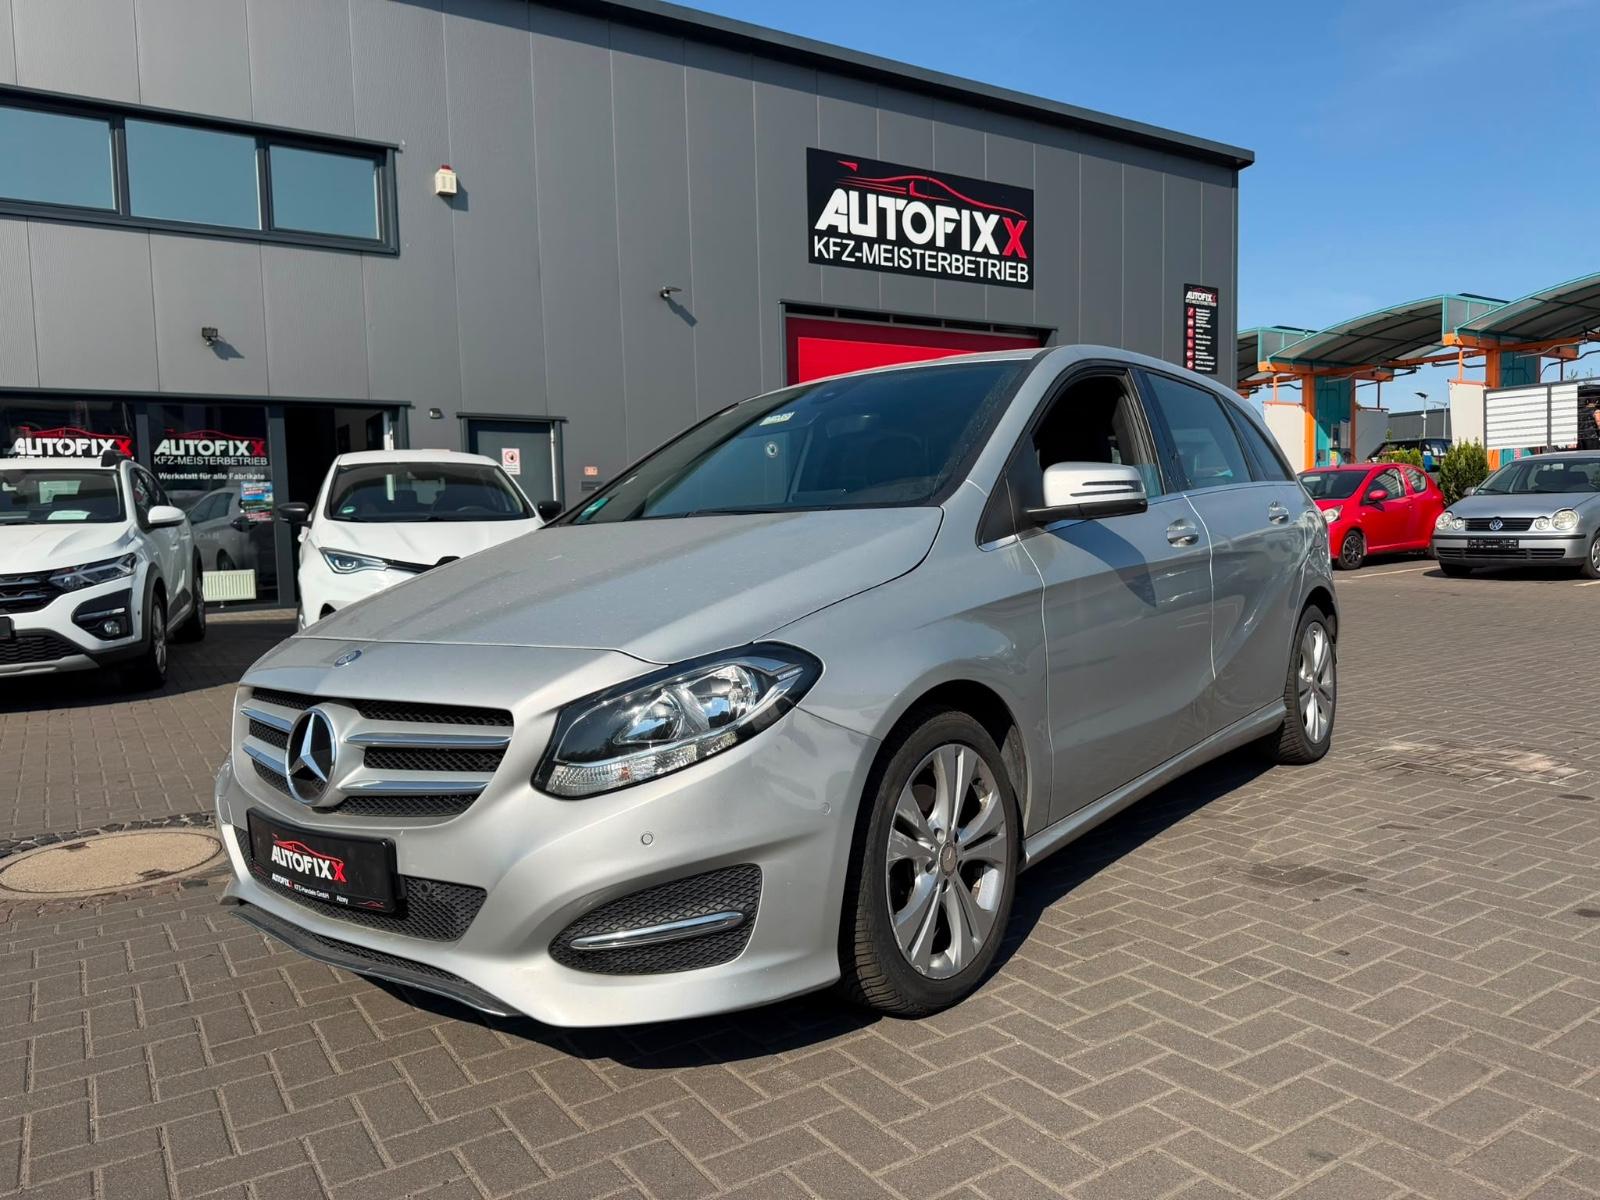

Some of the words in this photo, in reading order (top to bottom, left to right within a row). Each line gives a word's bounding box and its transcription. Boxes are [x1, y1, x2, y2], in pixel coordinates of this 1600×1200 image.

[814, 188, 1028, 259] AUTOFIXX
[813, 235, 1029, 283] KFZ-MEISTERBETRIEB
[153, 456, 268, 466] KFZ-MEISTERBETRIEB
[154, 439, 267, 456] AUTOFIXX
[158, 472, 198, 480] Werkstatt
[199, 472, 211, 480] für
[213, 472, 227, 480] alle
[229, 472, 265, 480] Fabrikate
[271, 845, 347, 883] AUTOFIXX
